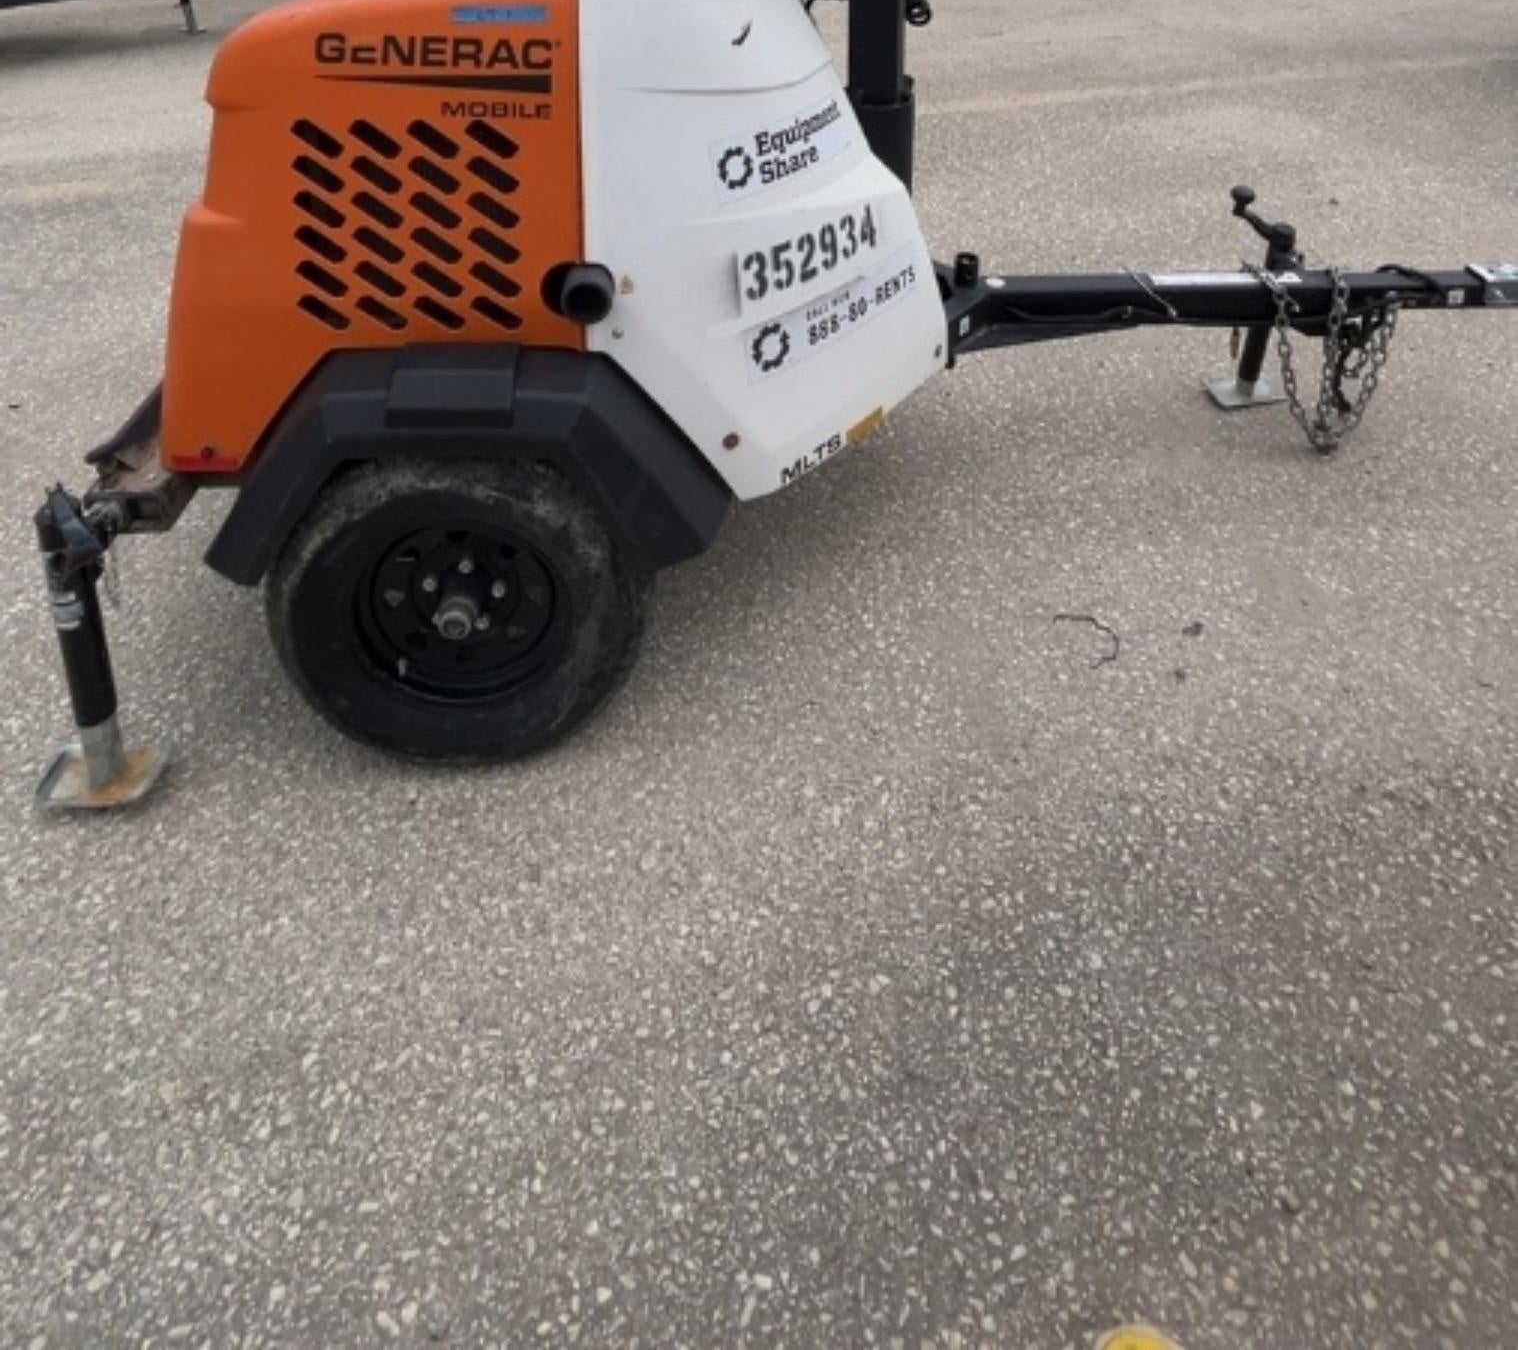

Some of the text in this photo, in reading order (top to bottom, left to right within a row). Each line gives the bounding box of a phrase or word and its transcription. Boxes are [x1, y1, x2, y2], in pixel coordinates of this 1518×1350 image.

[441, 101, 552, 119] MOBILE
[753, 98, 841, 156] Equipment
[758, 146, 819, 184] Share
[743, 202, 876, 301] 352934
[807, 265, 916, 346] 888-80-RENTS
